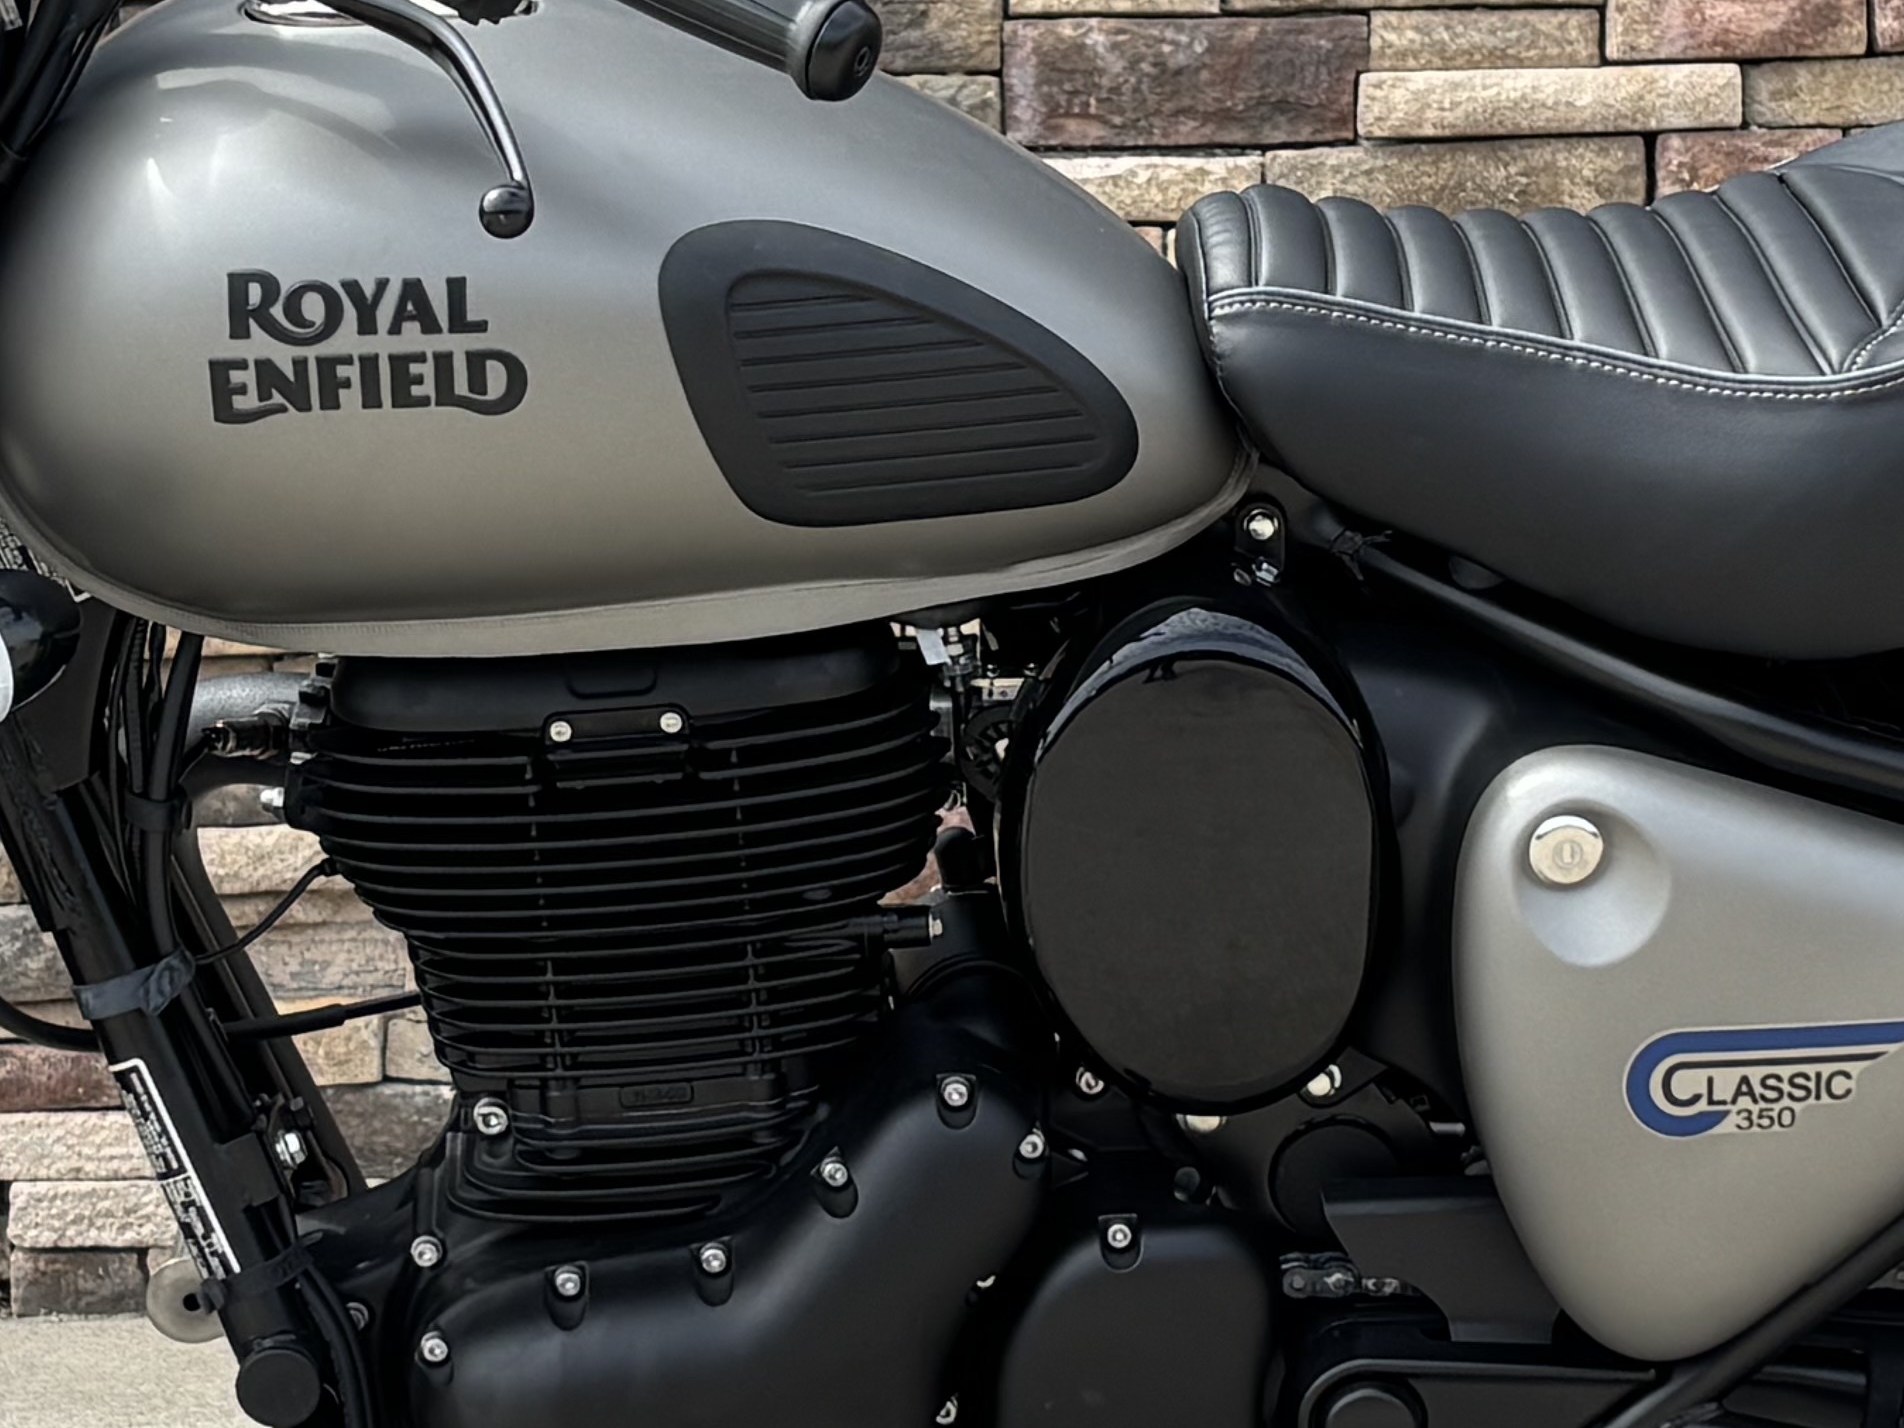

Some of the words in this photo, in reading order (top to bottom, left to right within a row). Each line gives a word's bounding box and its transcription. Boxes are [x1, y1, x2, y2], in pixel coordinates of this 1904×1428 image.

[227, 268, 488, 346] ROYAL
[208, 348, 528, 424] ENFIELD
[1662, 1054, 1881, 1107] CLASSIC
[1735, 1106, 1796, 1130] 350
